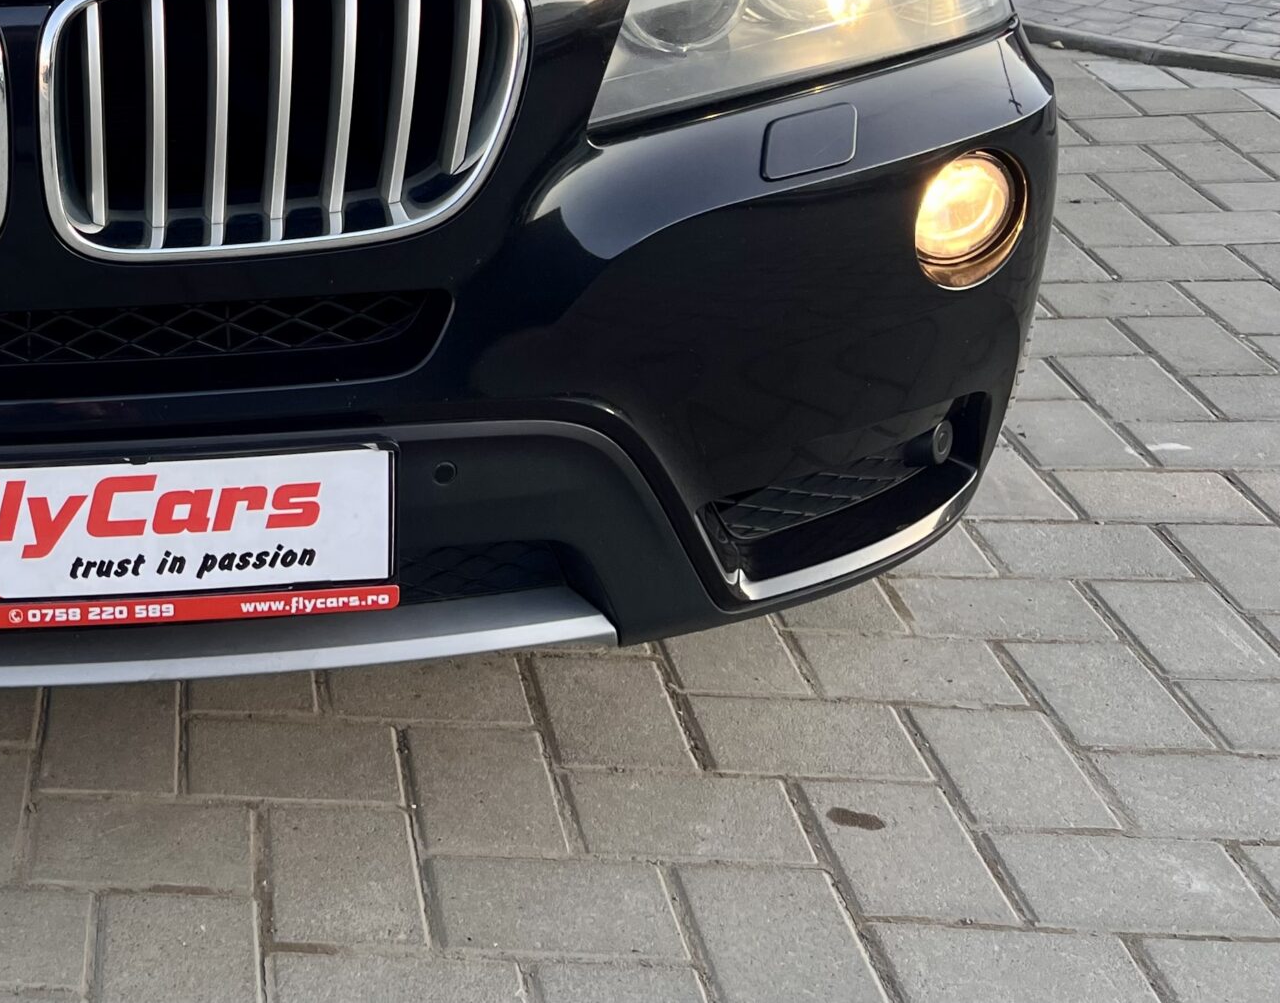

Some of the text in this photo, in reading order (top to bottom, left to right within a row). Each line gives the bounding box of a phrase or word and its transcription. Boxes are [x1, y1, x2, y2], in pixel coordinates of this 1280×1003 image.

[69, 543, 317, 580] trust in passion
[27, 603, 175, 623] 0758 220 589
[240, 594, 390, 614] www.flycars.ro
